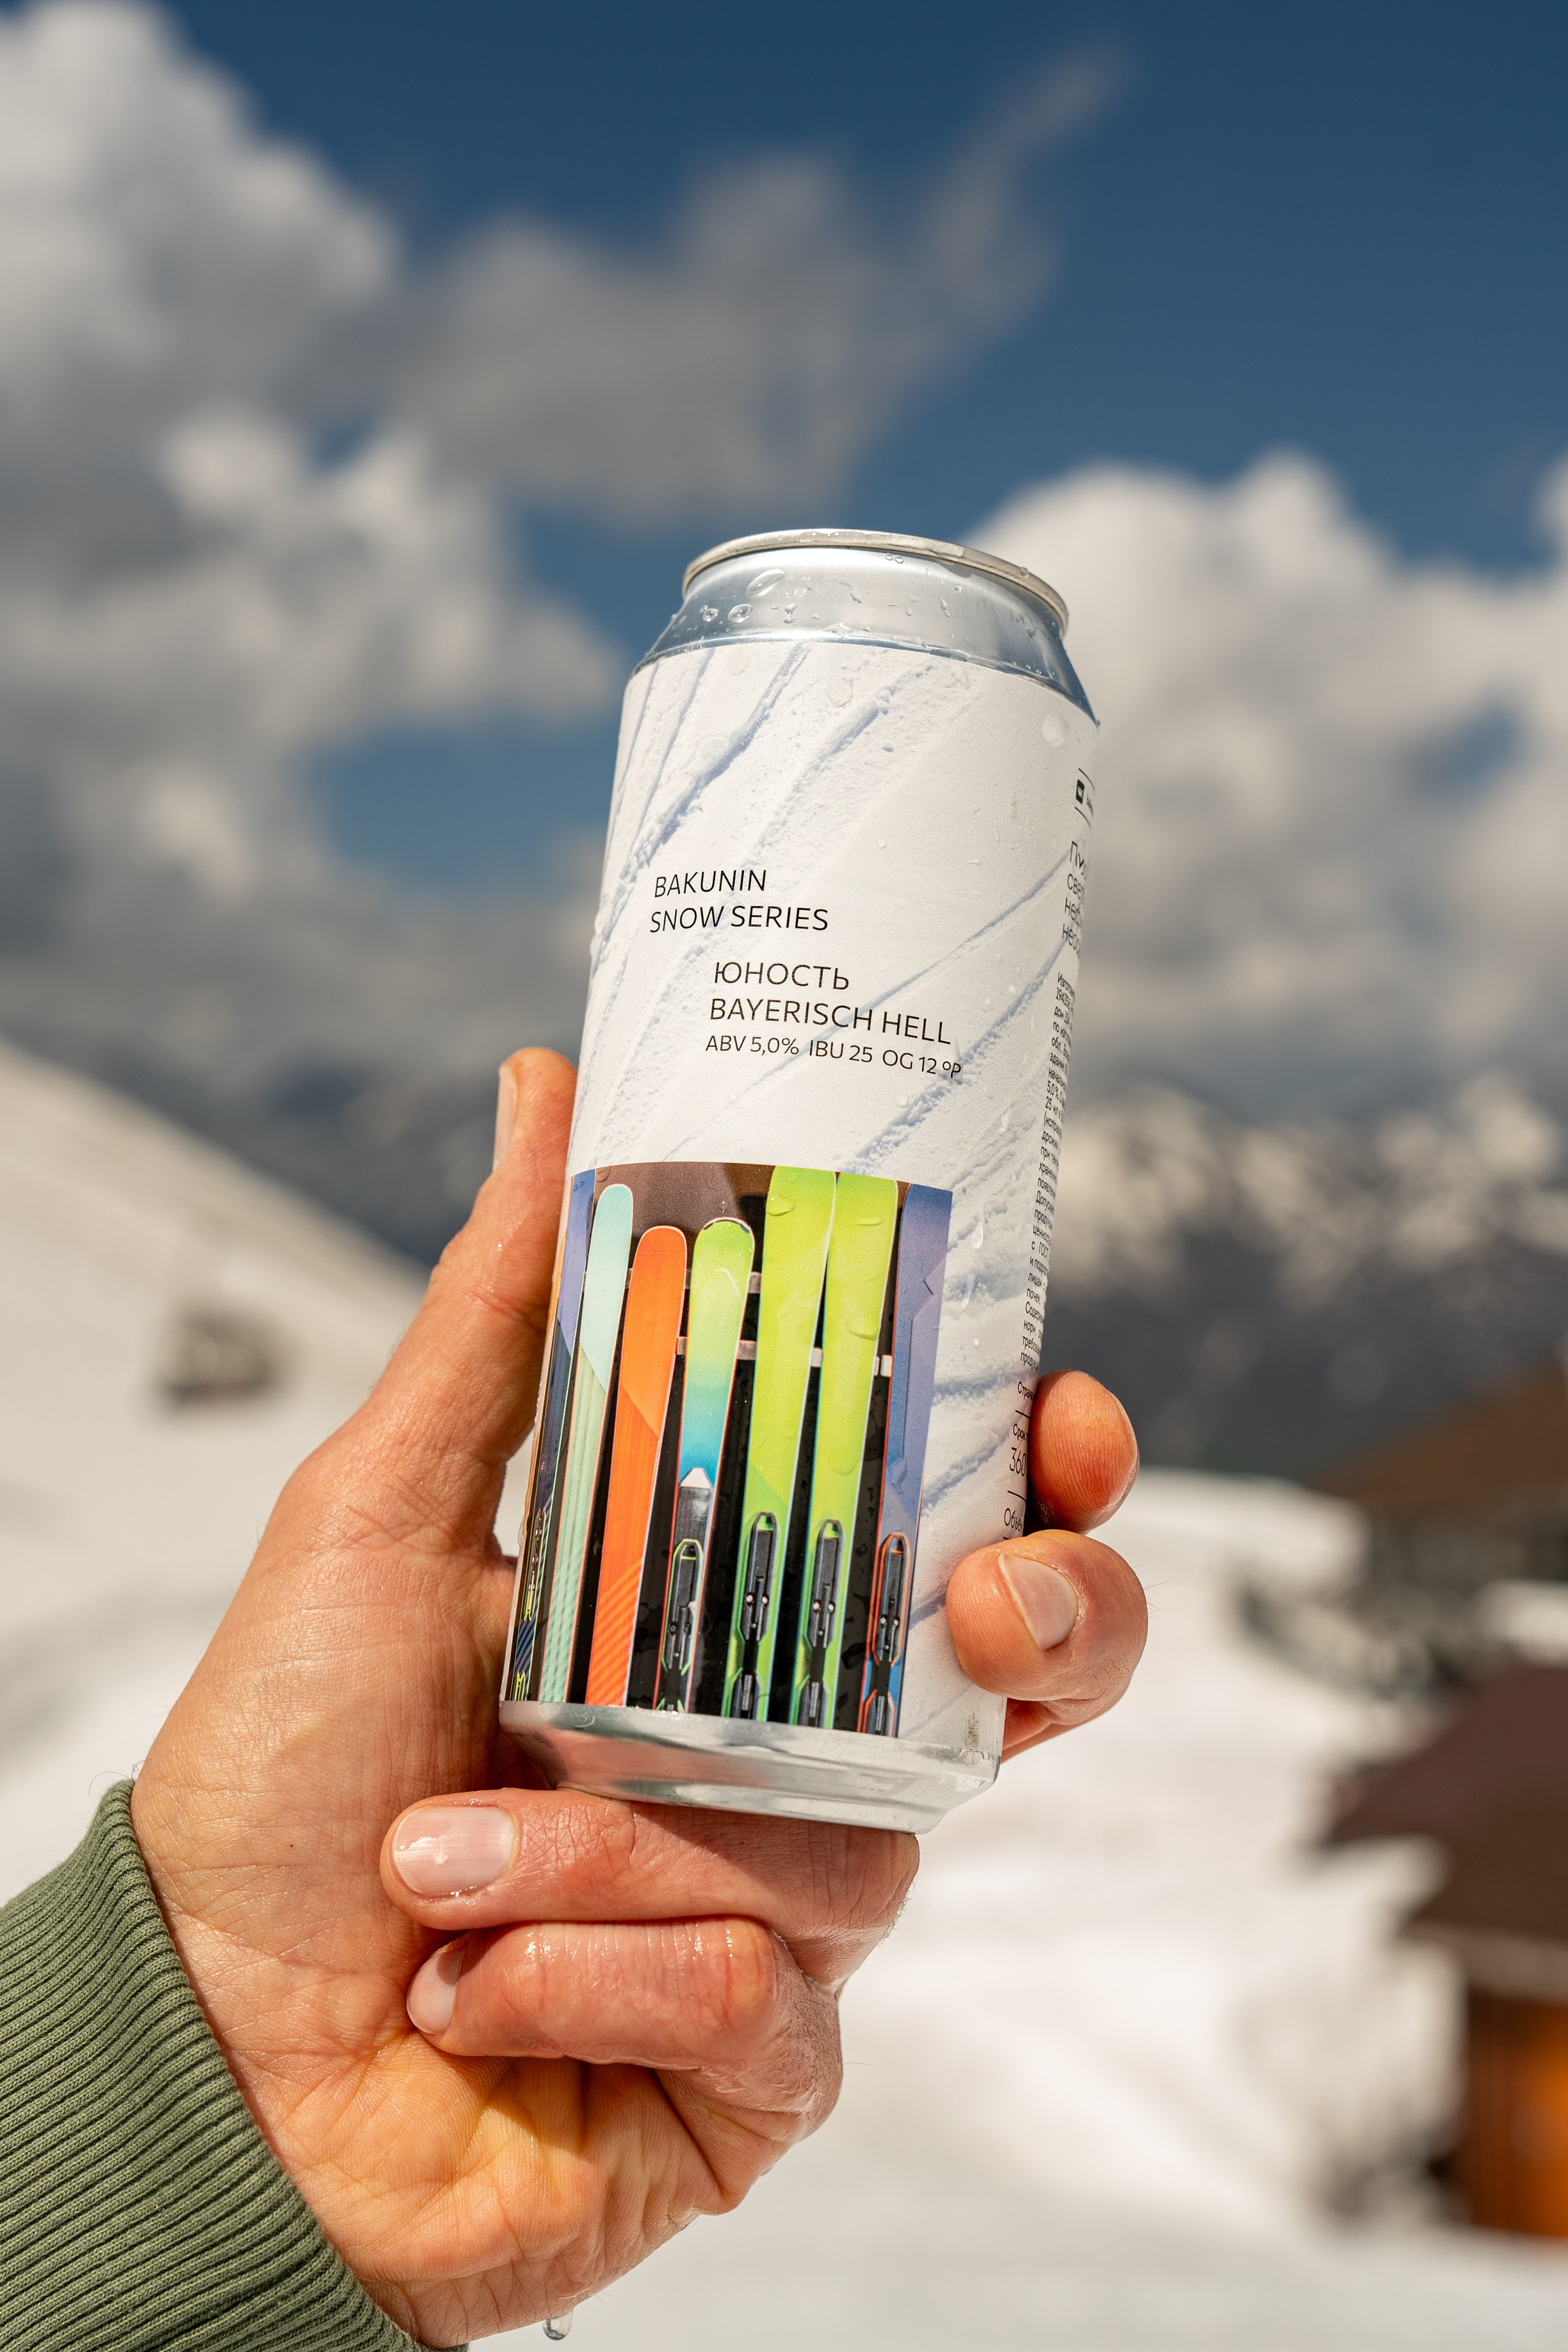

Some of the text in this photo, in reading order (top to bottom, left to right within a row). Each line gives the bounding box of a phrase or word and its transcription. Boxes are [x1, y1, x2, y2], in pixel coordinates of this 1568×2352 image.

[654, 870, 766, 898] BAKUNIN
[650, 905, 828, 933] SNOW SERIES
[714, 962, 849, 990] ЮНОСТЬ
[710, 998, 951, 1045] BAYERISCH HELL
[1053, 1022, 1060, 1033] по
[705, 1035, 747, 1052] ABV
[750, 1036, 799, 1056] 5,0%
[809, 1040, 844, 1059] IBU
[849, 1045, 873, 1063] 25
[882, 1050, 913, 1069] OG
[919, 1057, 937, 1075] 12
[1045, 1096, 1052, 1110] 25
[1040, 1146, 1050, 1161] при
[1031, 1240, 1035, 1250] с
[1009, 1447, 1027, 1477] 360
